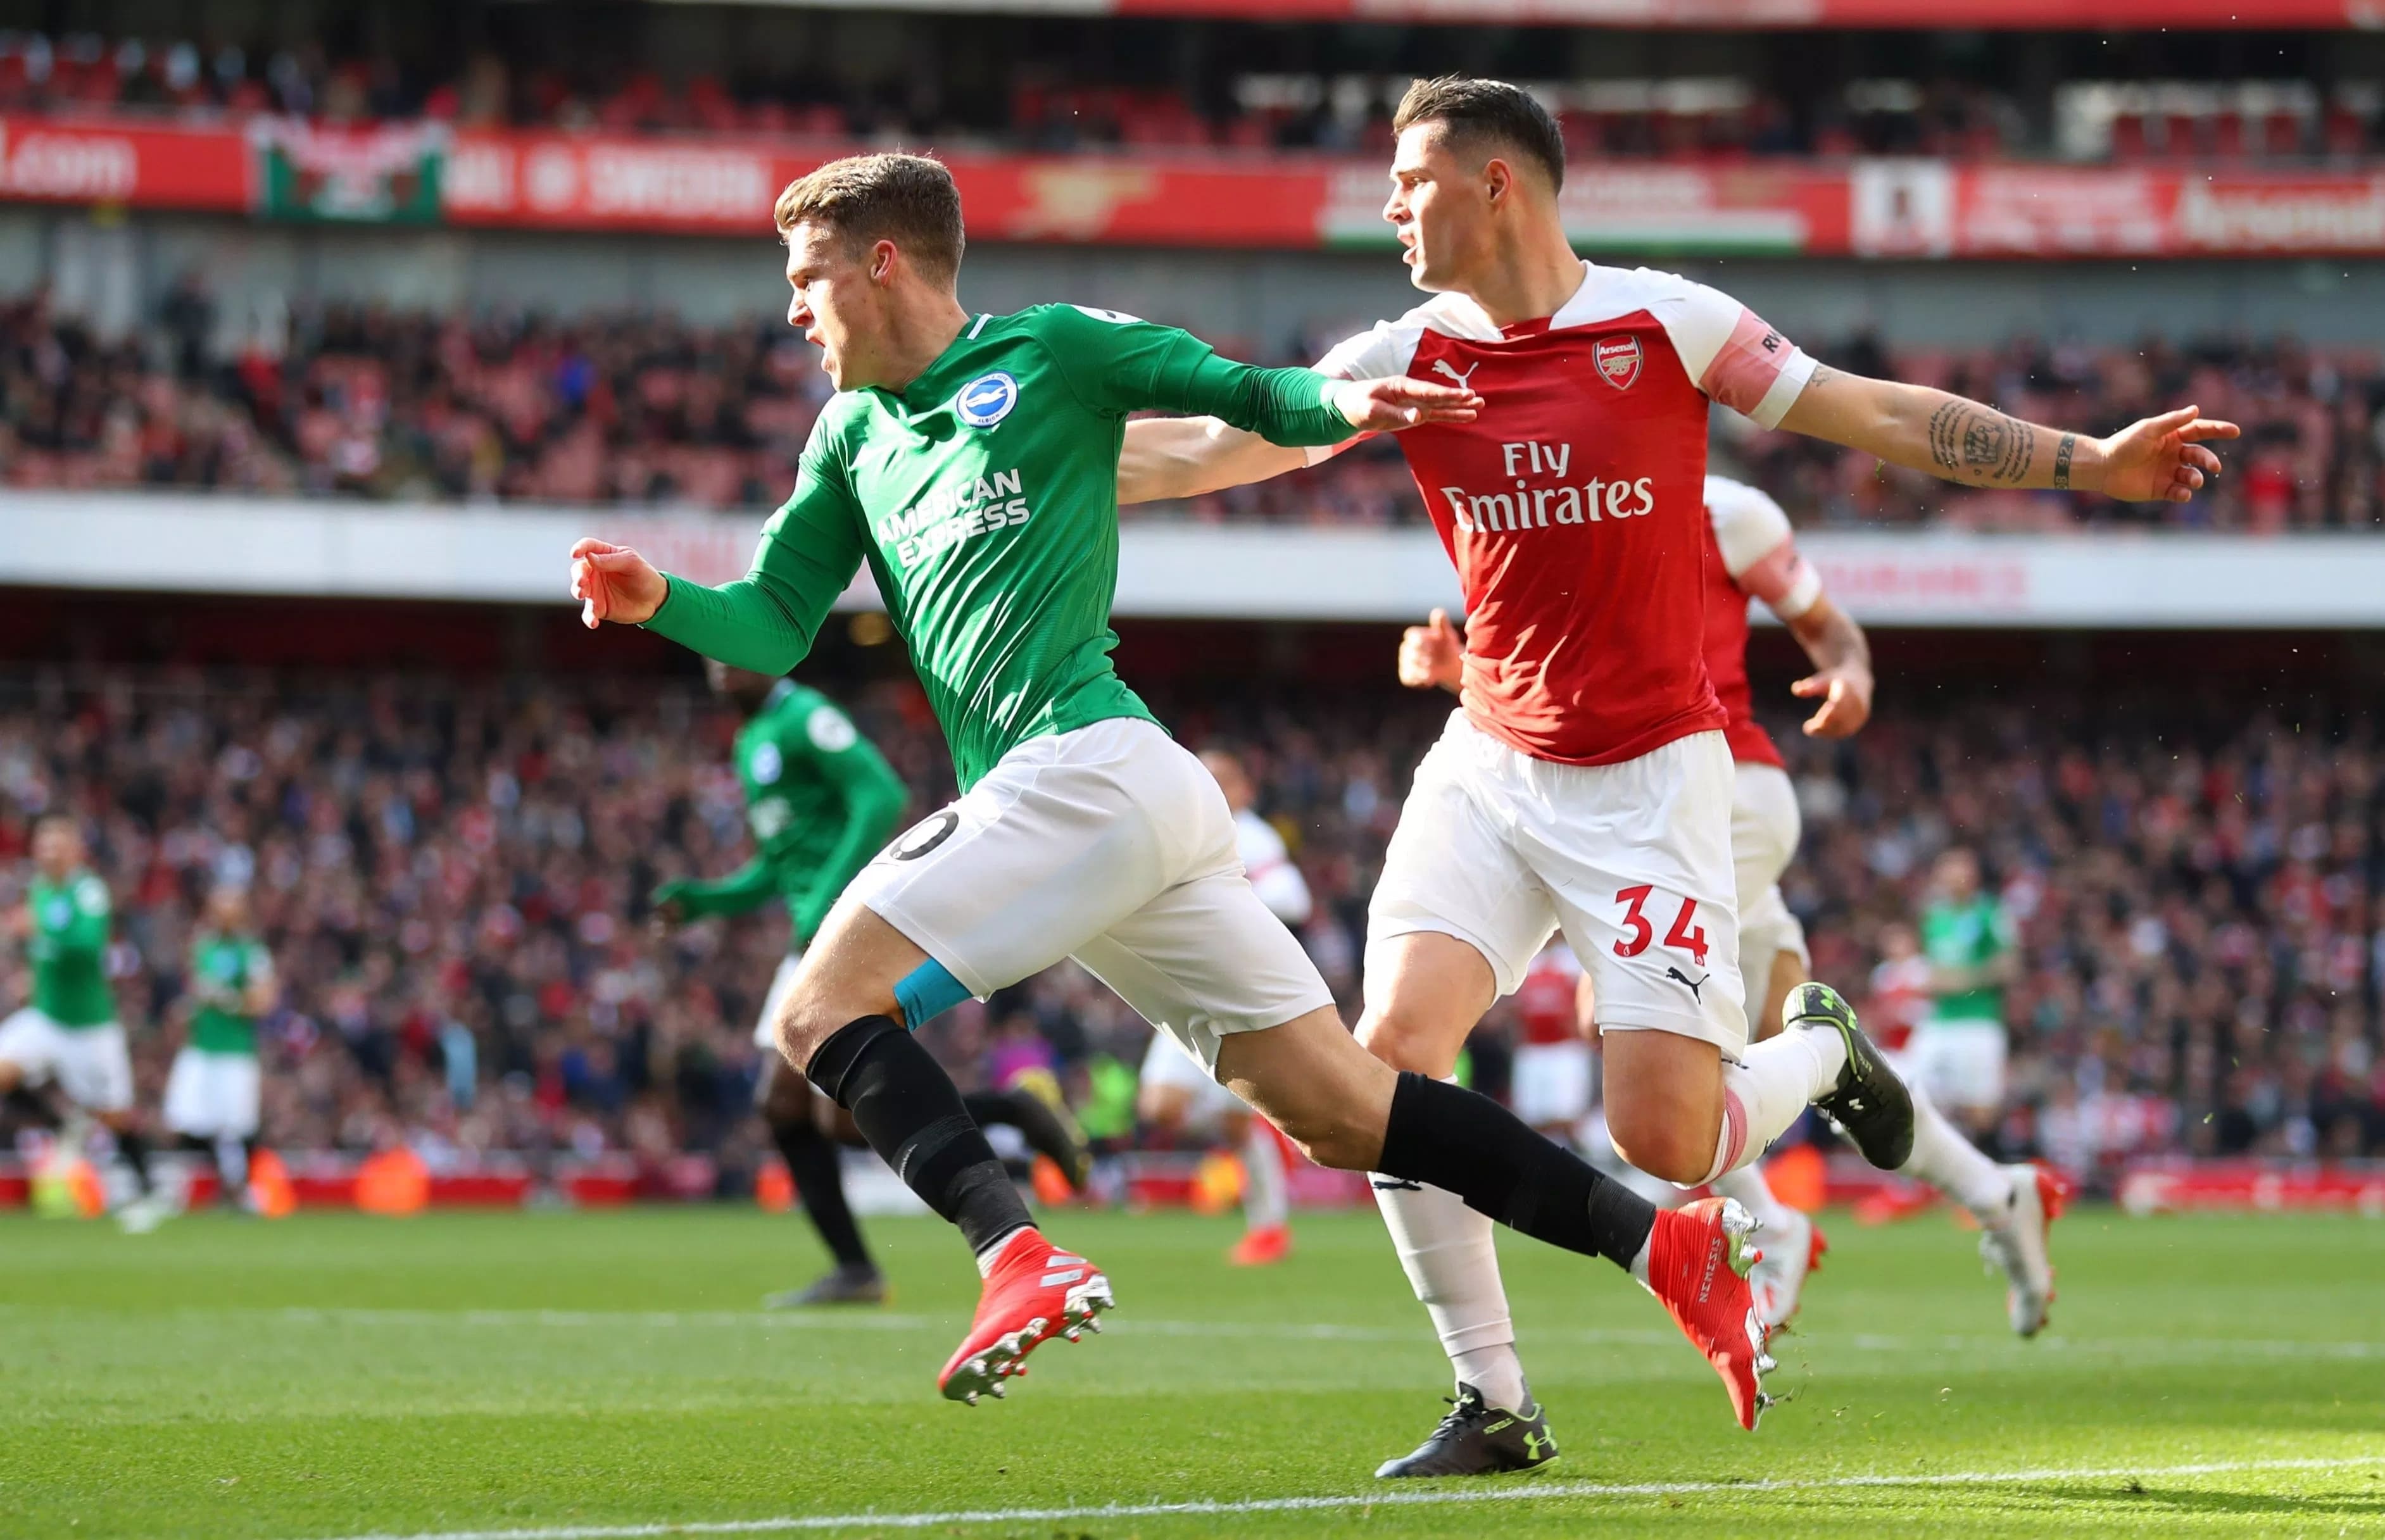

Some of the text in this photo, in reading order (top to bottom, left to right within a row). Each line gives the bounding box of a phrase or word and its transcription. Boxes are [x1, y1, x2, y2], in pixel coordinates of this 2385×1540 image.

[1599, 341, 1635, 356] Arsenal
[977, 413, 1000, 424] ALBION
[1501, 441, 1571, 479] Fly
[876, 468, 1023, 548] AMERICAN
[895, 497, 1030, 569] EXPRESS
[1439, 475, 1654, 533] Emirates
[1613, 884, 1709, 967] 34
[1698, 1236, 1721, 1303] NEMESIS
